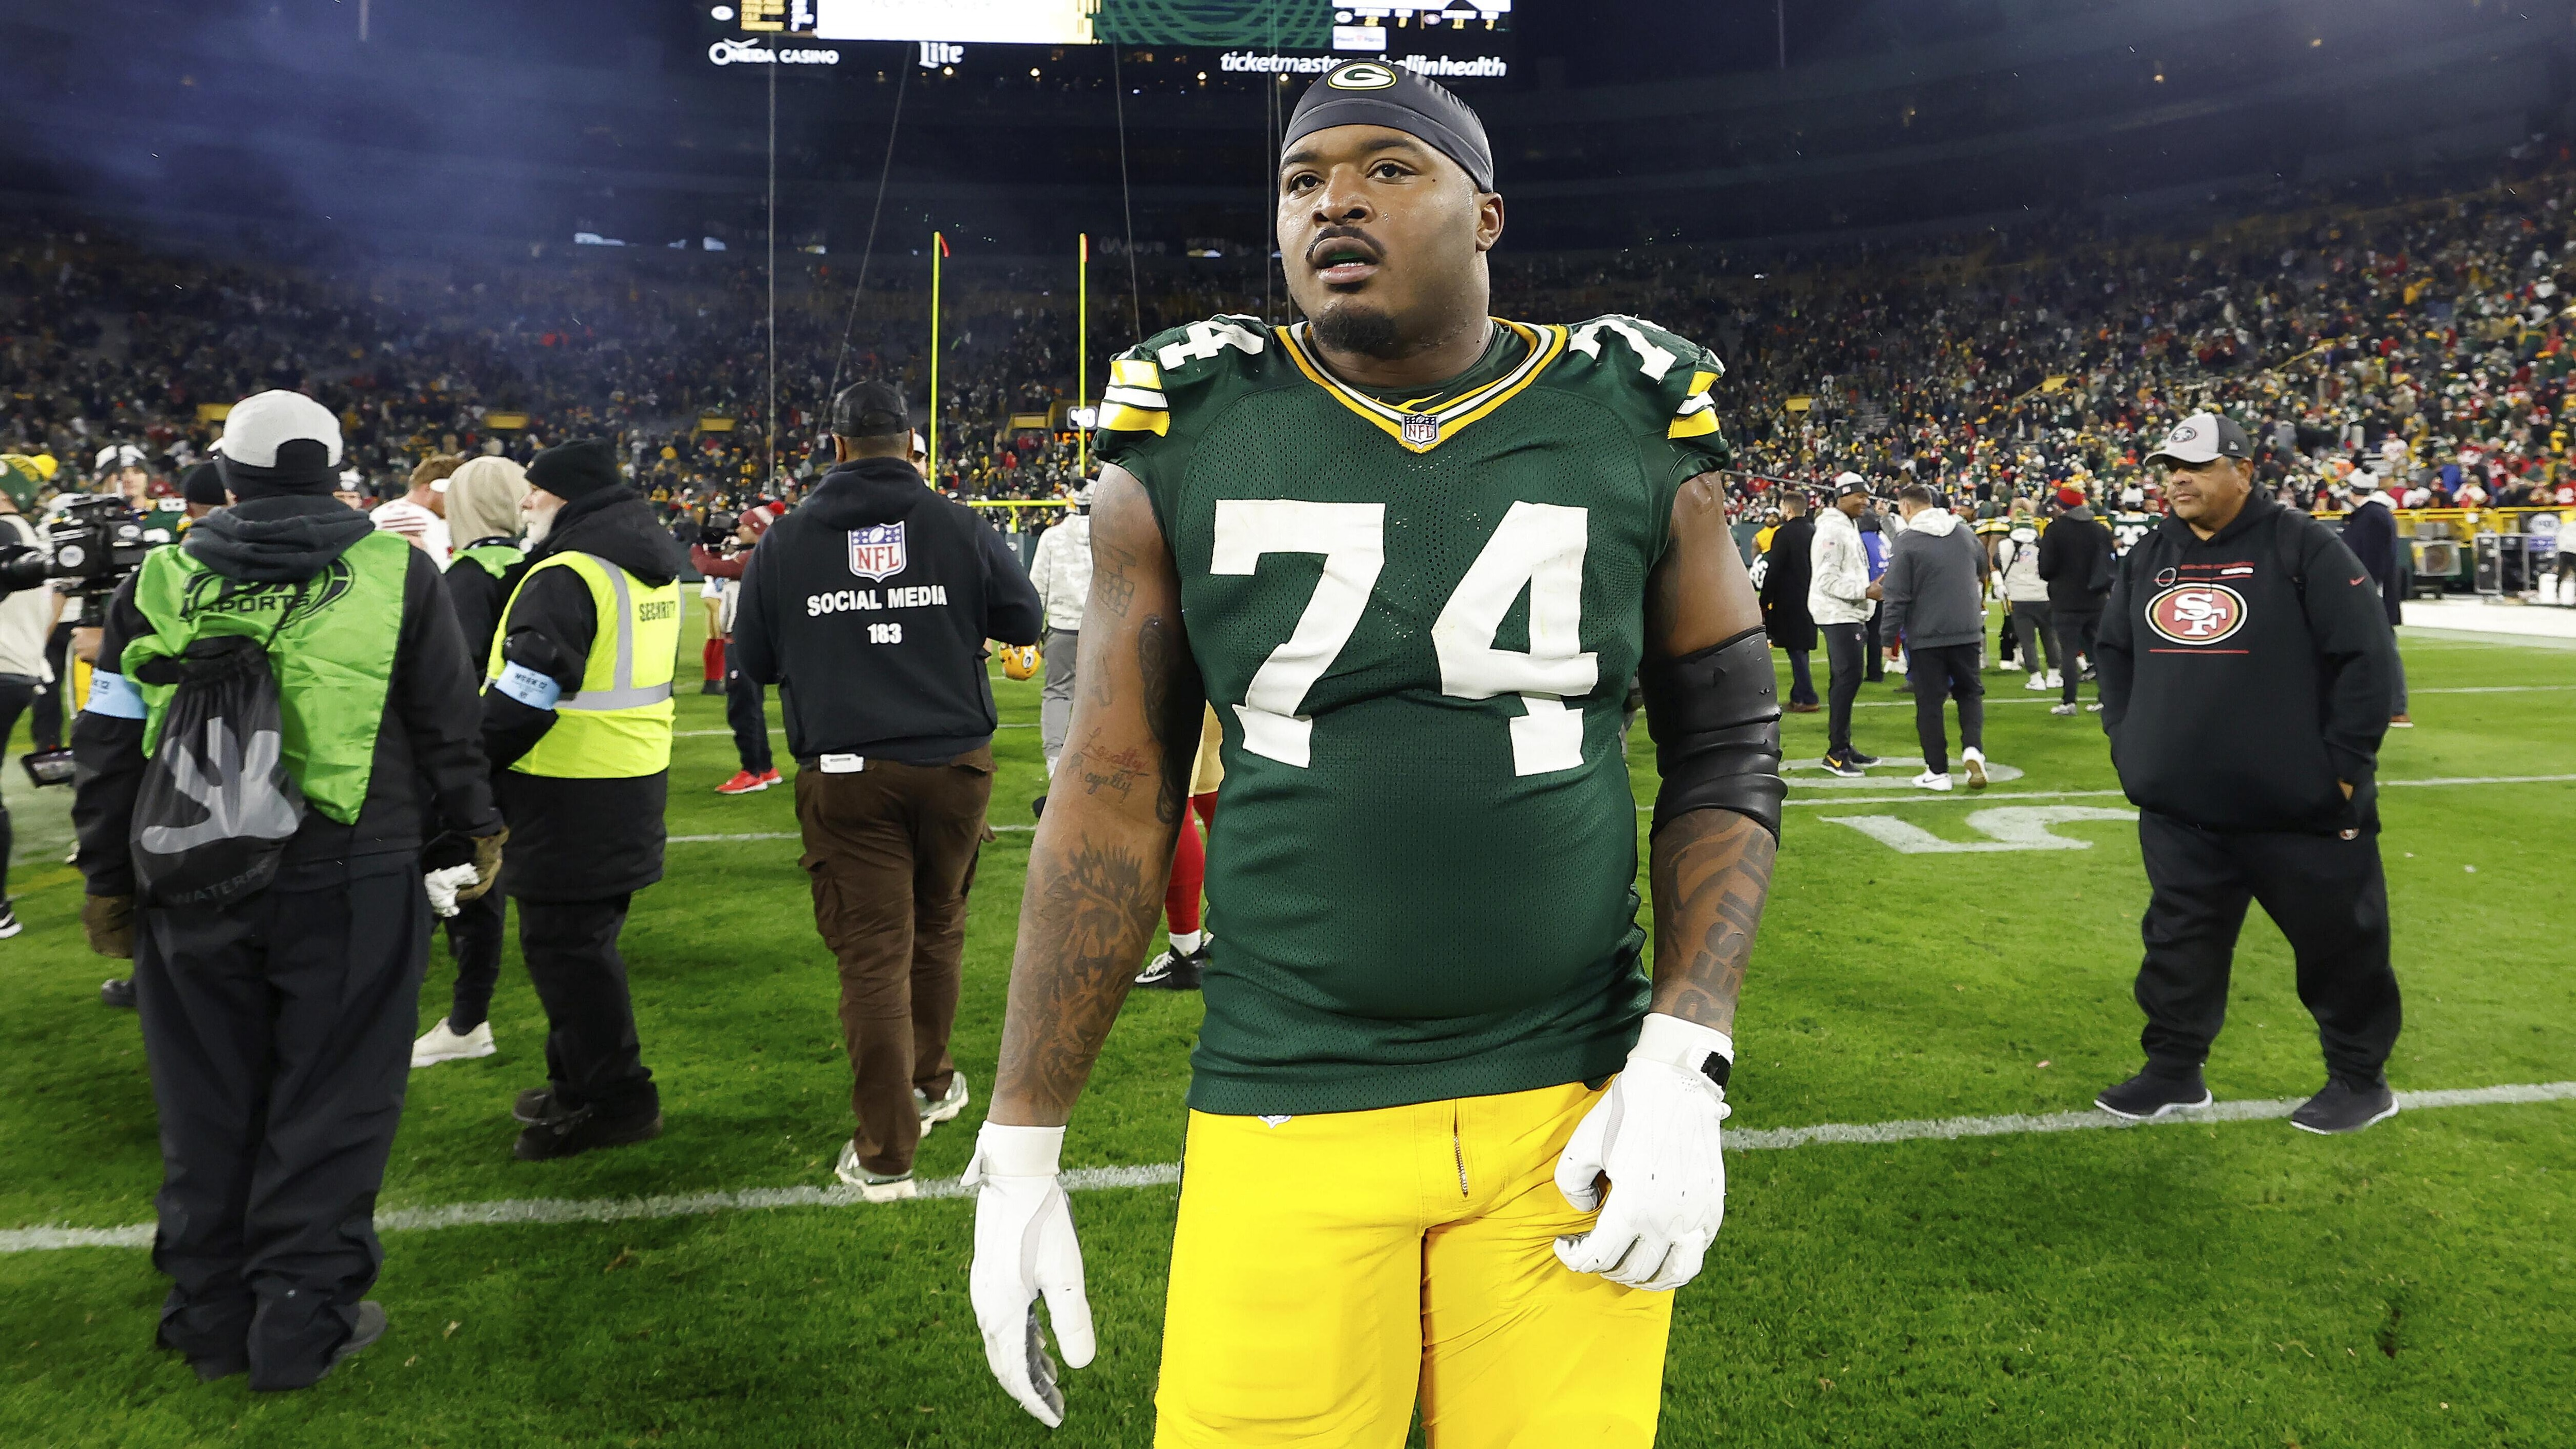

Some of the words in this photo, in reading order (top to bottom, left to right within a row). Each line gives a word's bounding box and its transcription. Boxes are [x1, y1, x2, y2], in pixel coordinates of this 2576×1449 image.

[779, 49, 839, 65] CASINO
[919, 41, 964, 69] Lite
[1220, 51, 1352, 73] ticketmaste
[1331, 64, 1392, 88] G
[1408, 425, 1433, 440] NFL
[855, 546, 900, 572] NFL
[807, 589, 883, 617] SOCIAL
[887, 585, 948, 609] MEDIA
[2174, 593, 2228, 635] SF
[867, 622, 902, 644] 183
[1210, 499, 1599, 777] 74
